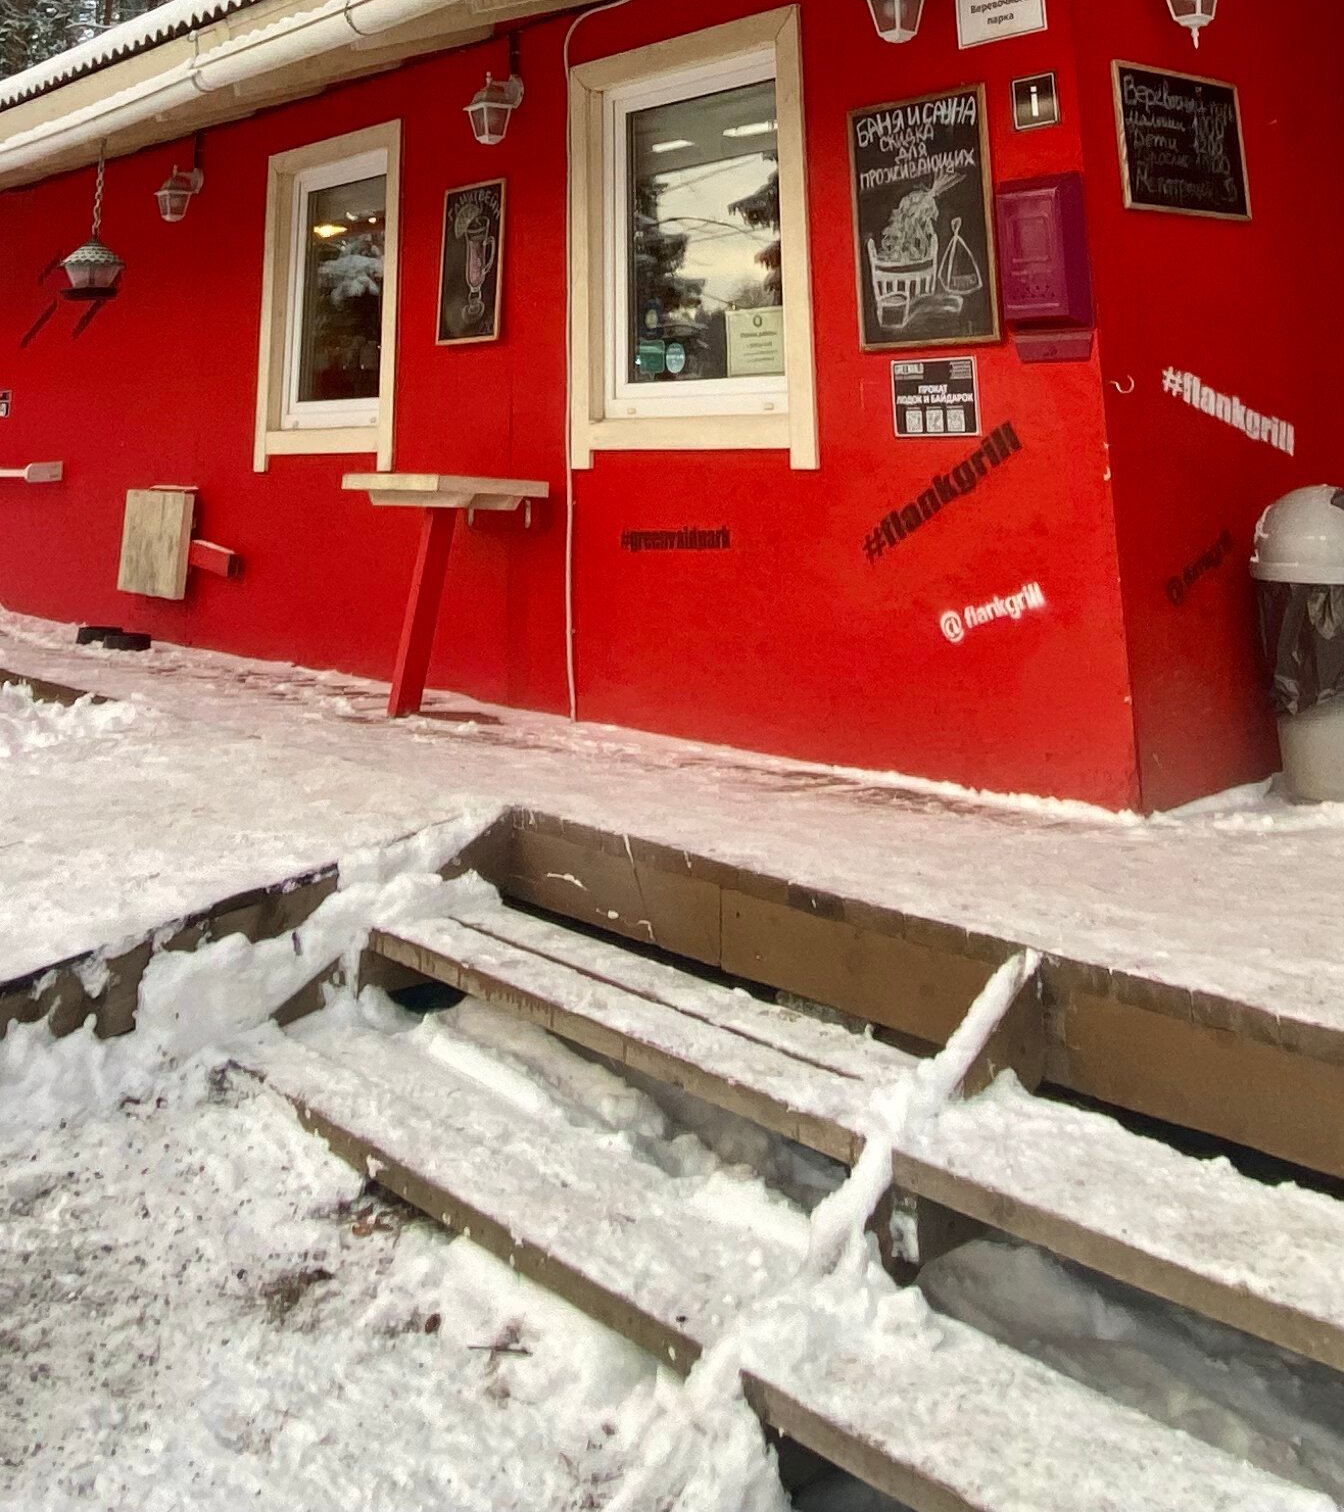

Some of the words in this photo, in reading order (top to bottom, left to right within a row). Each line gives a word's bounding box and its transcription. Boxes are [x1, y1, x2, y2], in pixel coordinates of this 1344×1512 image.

[987, 12, 1015, 25] парка
[856, 108, 905, 148] БАНЯ
[907, 105, 920, 126] И
[922, 95, 977, 126] САУНА
[879, 122, 935, 152] СКИДКА
[895, 141, 928, 164] ДЛЯ
[859, 147, 977, 189] ПРОЖИВАЮЩИХ
[896, 394, 923, 405] ЛОДОК
[930, 392, 974, 405] БАЙДАРОК
[918, 383, 948, 394] ПРОКАТ
[1161, 365, 1295, 457] #flankgrill
[862, 420, 1023, 566] #flankgrill
